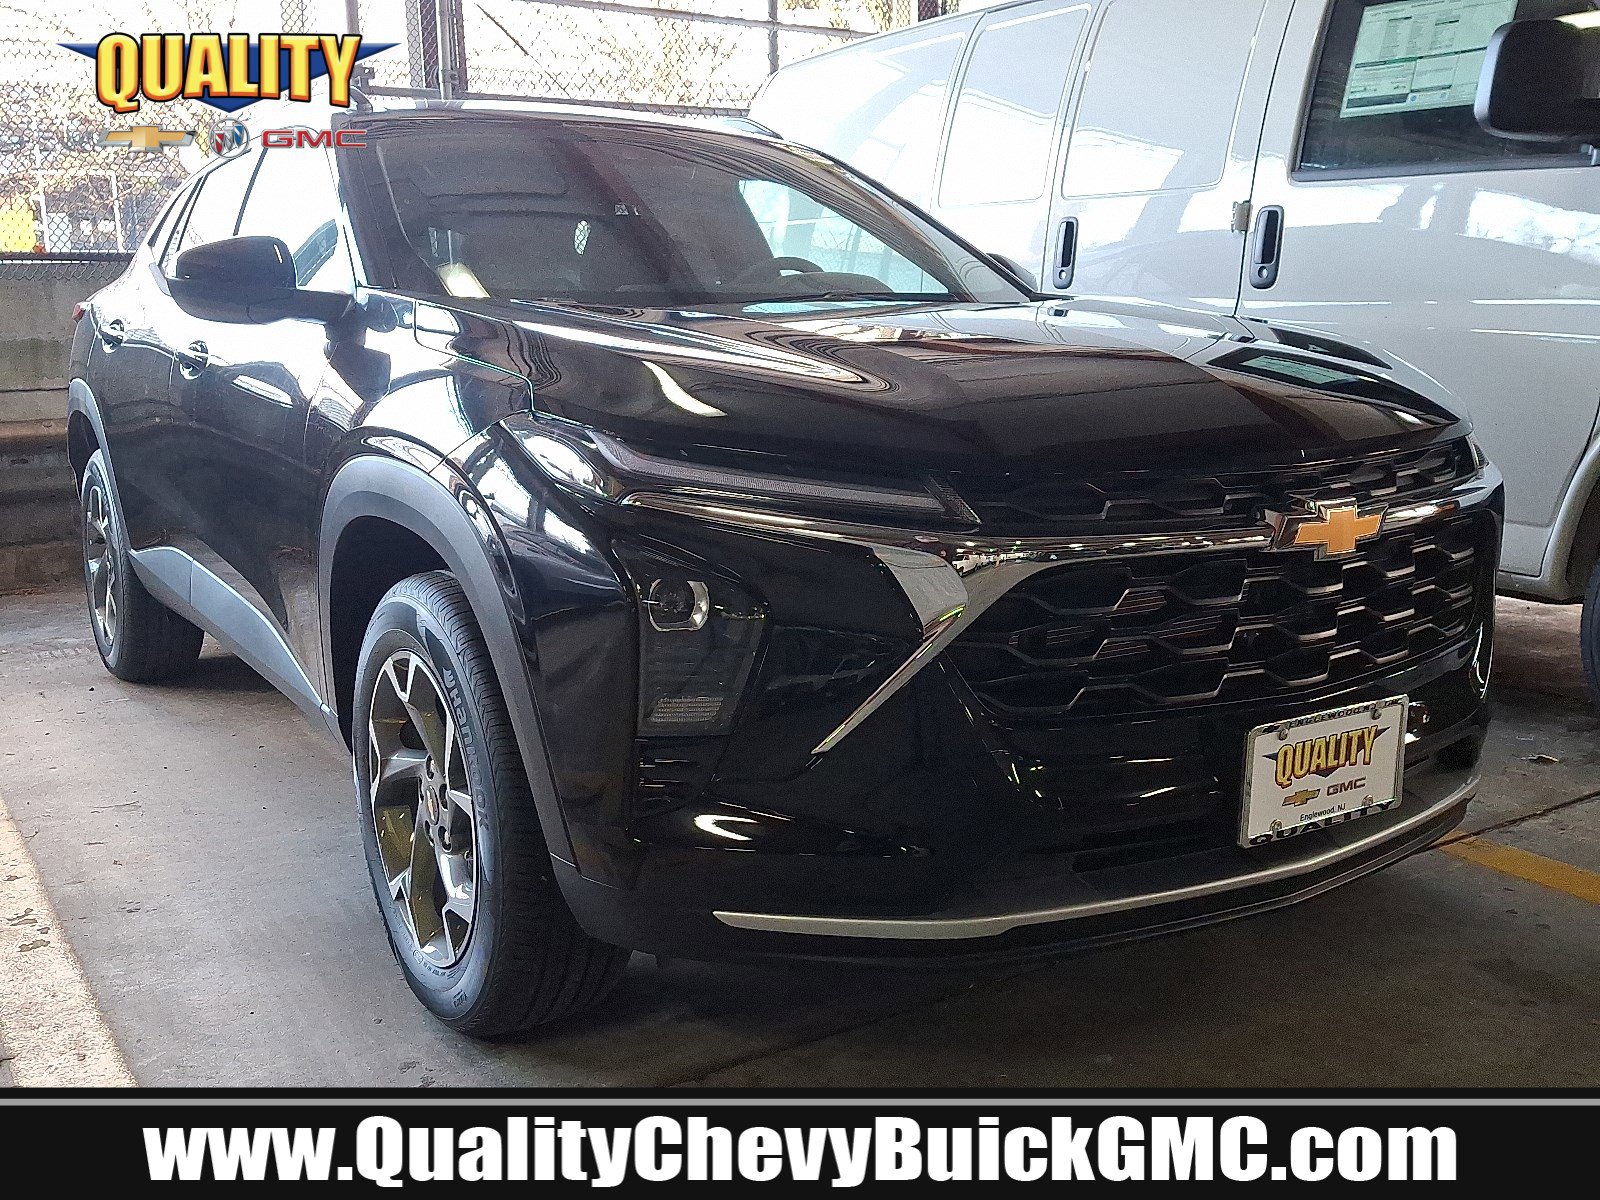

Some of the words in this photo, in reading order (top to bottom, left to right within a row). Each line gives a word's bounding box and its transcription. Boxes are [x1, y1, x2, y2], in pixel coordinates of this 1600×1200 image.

[1275, 725, 1378, 788] QUALITY
[1326, 776, 1367, 797] GMC
[1337, 803, 1346, 813] NJ
